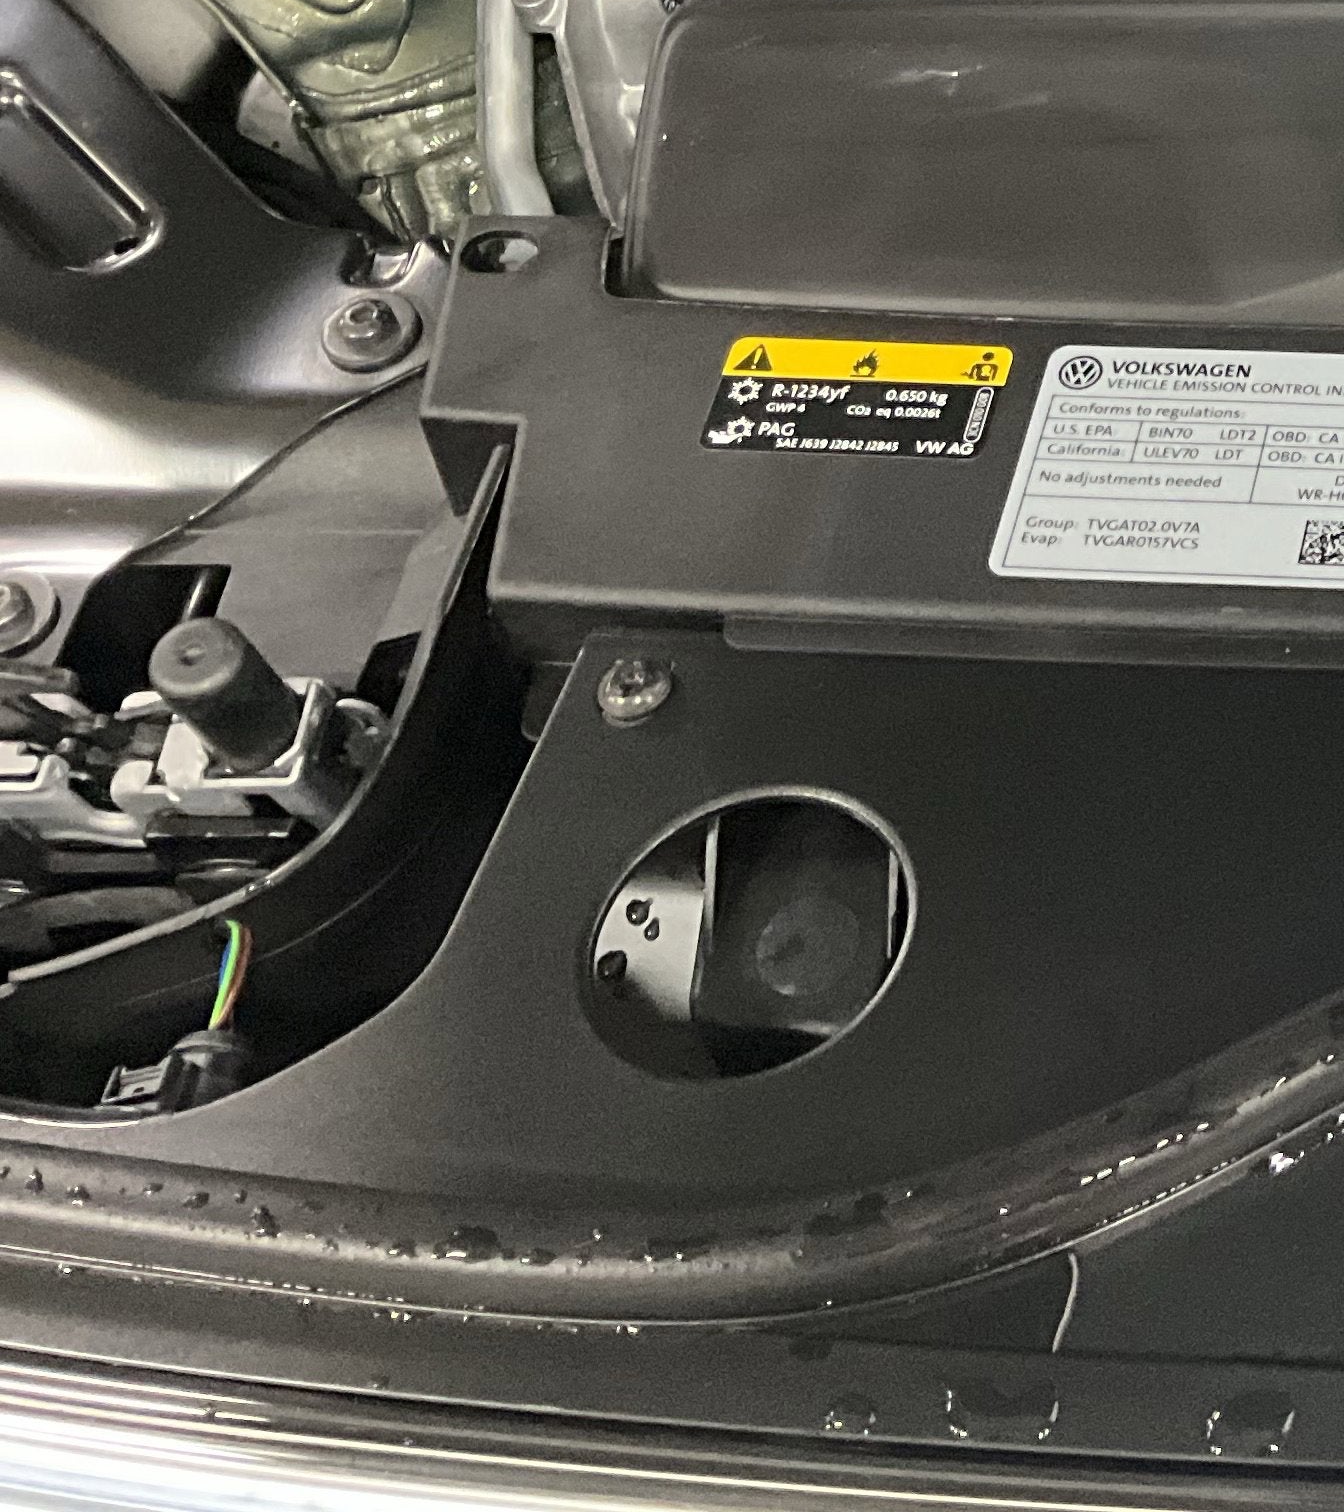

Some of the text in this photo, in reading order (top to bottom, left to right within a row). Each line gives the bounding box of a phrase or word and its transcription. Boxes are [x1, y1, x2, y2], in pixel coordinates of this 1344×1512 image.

[1112, 360, 1252, 378] VOLKSWAGEN
[771, 383, 851, 404] R-1234yf
[1107, 377, 1168, 390] VEHICLE
[1173, 380, 1248, 393] EMISSION
[1251, 382, 1321, 397] CONTROL
[885, 388, 949, 407] 0.650 kg
[765, 402, 797, 413] GWP
[875, 407, 892, 419] eq
[894, 406, 941, 419] 0.0026t
[1059, 401, 1132, 416] Conforms
[1136, 404, 1151, 416] to
[758, 421, 796, 437] PAG
[1149, 426, 1194, 439] BIN70
[1219, 429, 1257, 441] LDT2
[1318, 432, 1339, 445] CA
[775, 438, 799, 448] SAE
[915, 440, 975, 456] VW AG
[1144, 447, 1200, 460] ULEV70
[1215, 449, 1243, 461] LDT
[1314, 452, 1335, 464] CA
[1039, 470, 1223, 488] No adjustments needed
